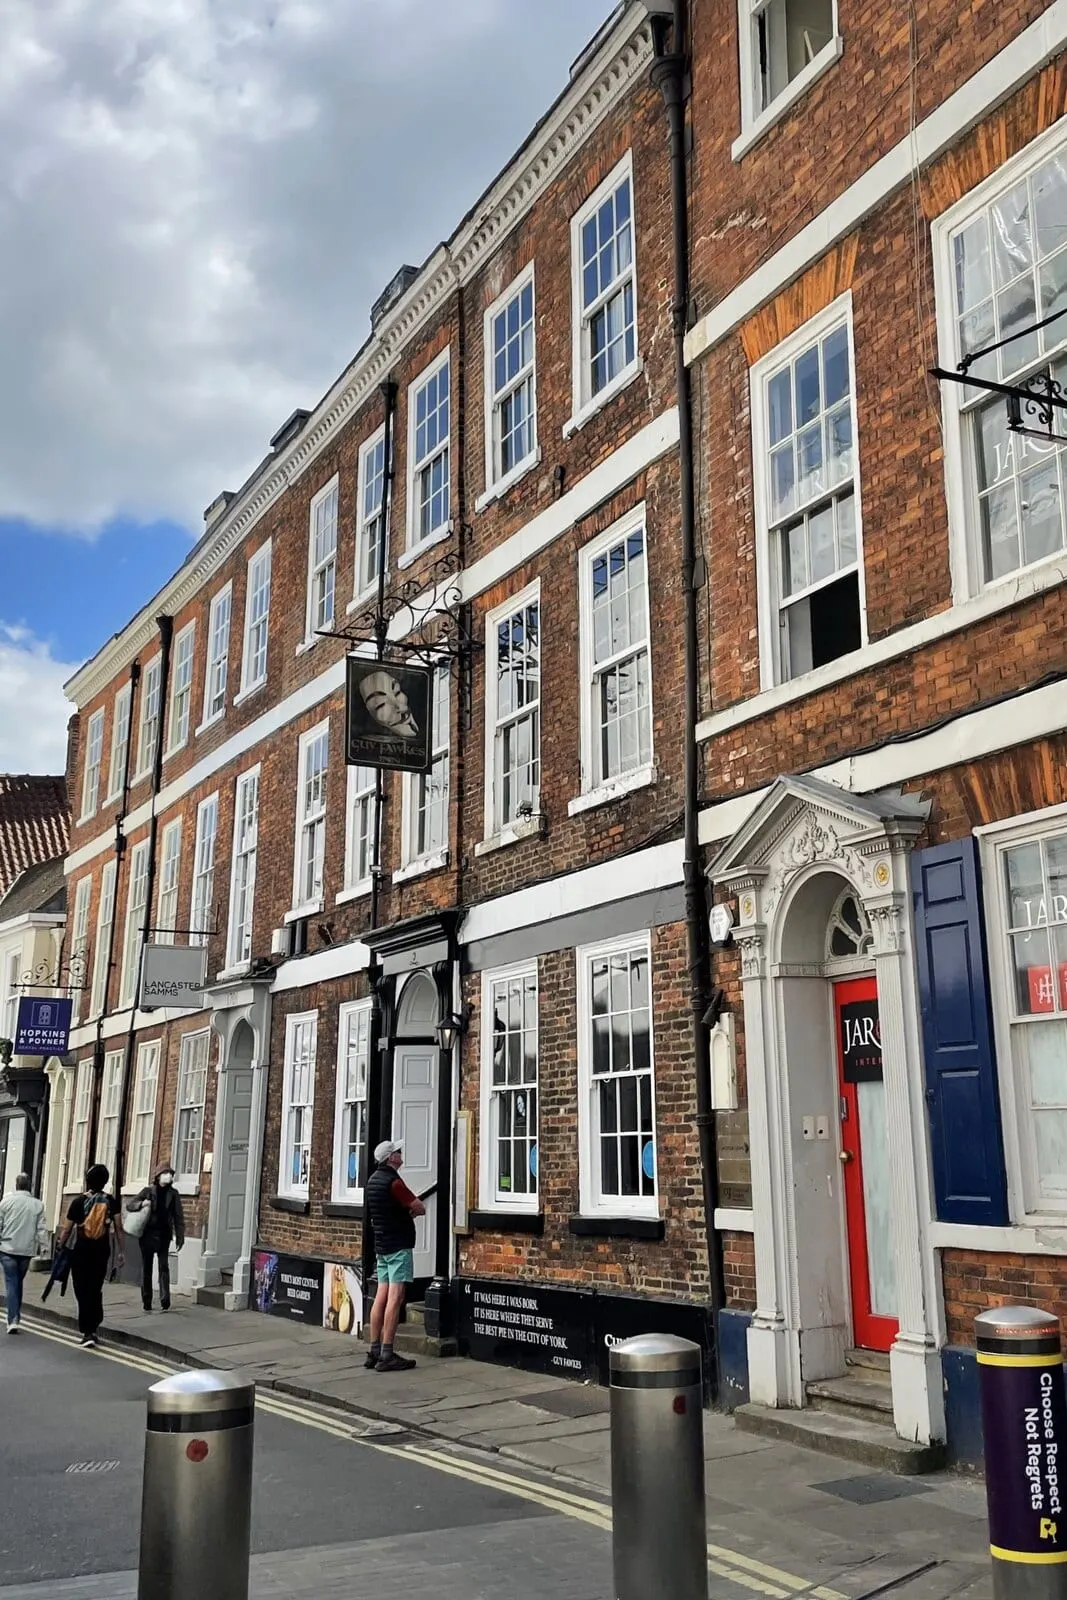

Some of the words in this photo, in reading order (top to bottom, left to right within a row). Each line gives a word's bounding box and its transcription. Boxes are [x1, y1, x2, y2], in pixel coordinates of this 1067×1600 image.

[379, 739, 425, 756] FAWKES
[144, 981, 201, 990] LANCASTER
[144, 988, 178, 996] SAMMS
[20, 1029, 66, 1038] HOPKINS
[844, 1017, 882, 1054] JAR
[474, 1291, 479, 1302] IT
[479, 1292, 491, 1304] WAS
[491, 1293, 506, 1306] HERE
[509, 1295, 522, 1308] WAS
[474, 1307, 480, 1318] IT
[480, 1307, 485, 1319] IS
[485, 1308, 500, 1321] HERE
[500, 1311, 520, 1324] WHERE
[520, 1313, 535, 1327] THEY
[535, 1316, 553, 1330] SERVE
[474, 1322, 485, 1335] THE
[485, 1324, 498, 1337] BEST
[498, 1326, 507, 1339] PIE
[507, 1328, 515, 1339] IN
[515, 1329, 526, 1342] THE
[526, 1331, 540, 1344] CITY
[540, 1333, 549, 1346] OF
[1040, 1373, 1054, 1438] Choose
[1025, 1408, 1039, 1440] Not
[1026, 1444, 1042, 1510] Regrets
[1045, 1443, 1062, 1514] Respect
